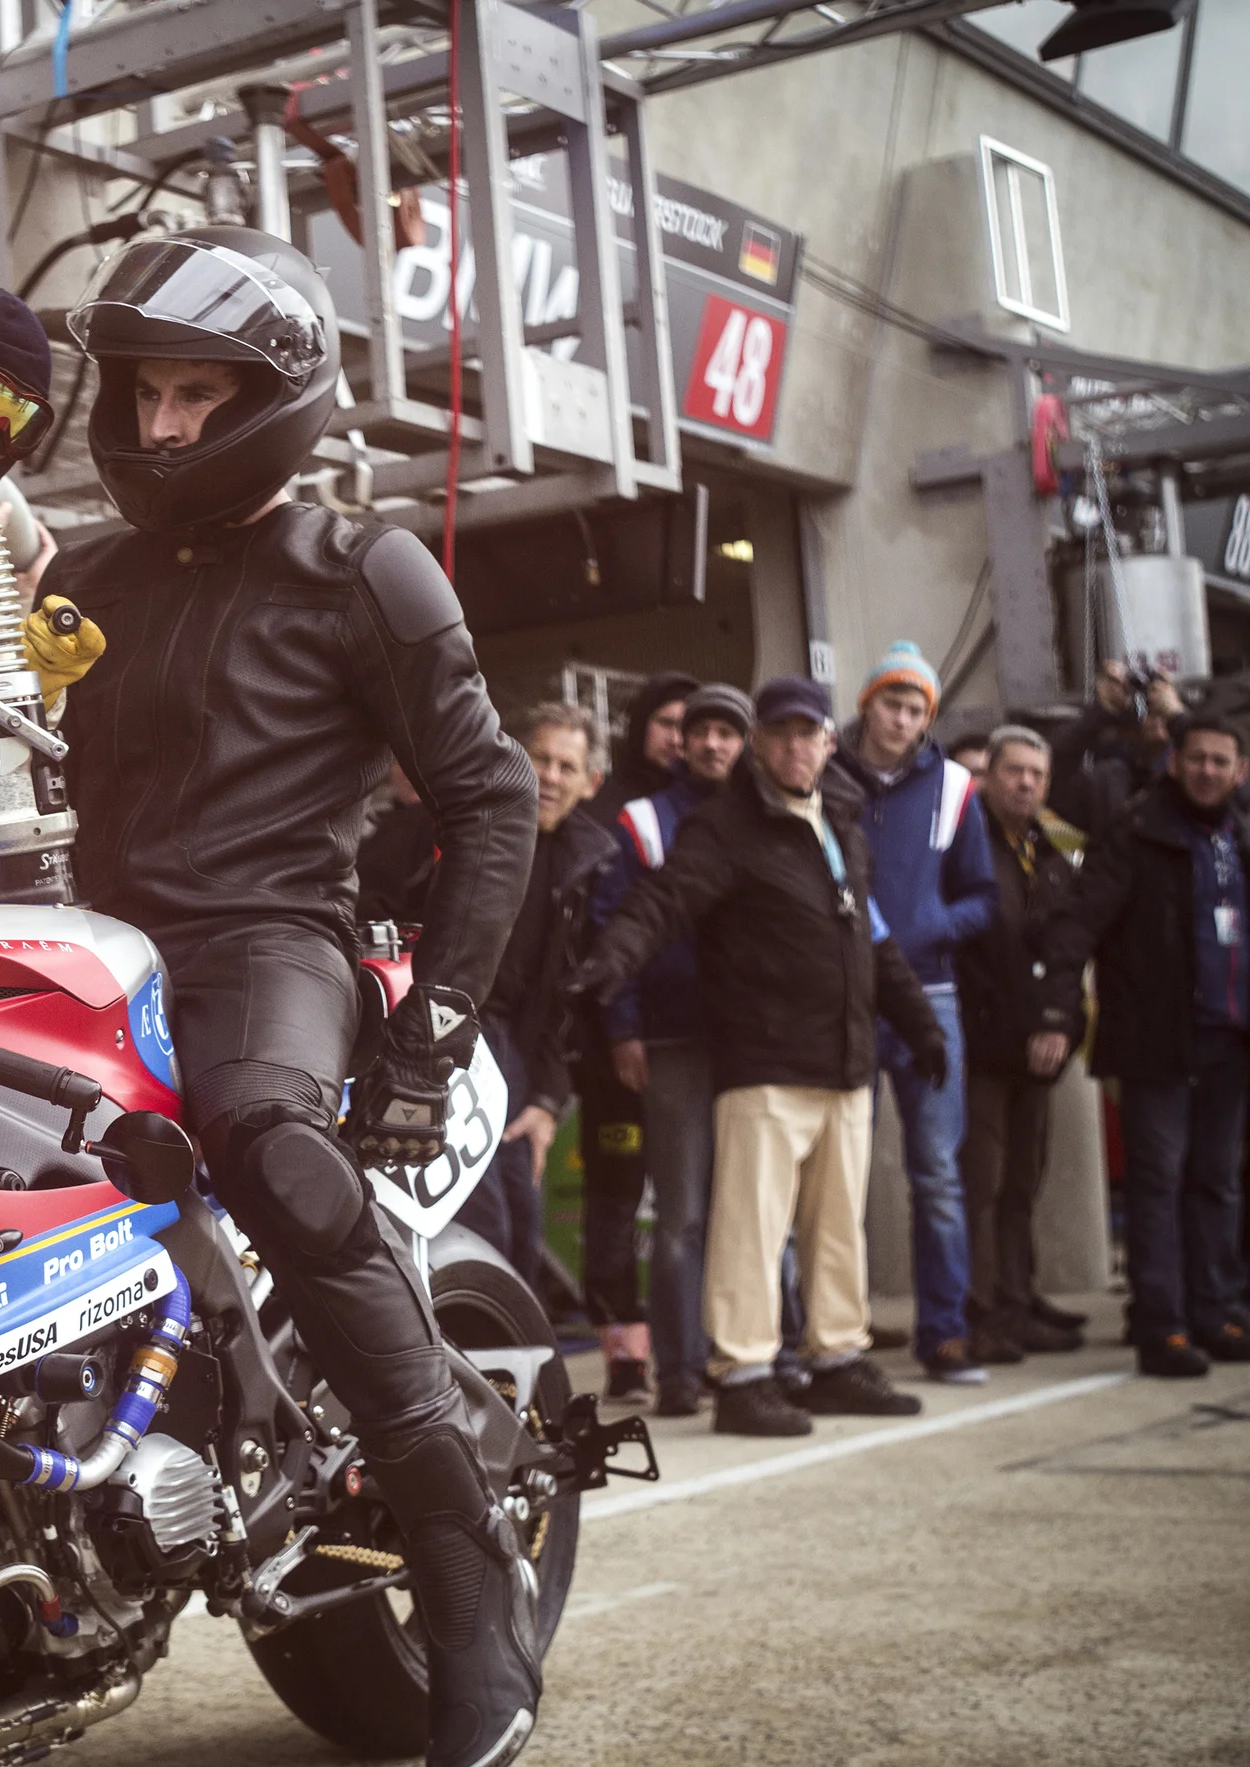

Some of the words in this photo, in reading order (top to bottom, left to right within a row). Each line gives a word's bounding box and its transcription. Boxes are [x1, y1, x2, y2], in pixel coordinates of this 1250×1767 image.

[705, 308, 773, 427] 48
[43, 1248, 84, 1286] Pro
[90, 1218, 134, 1261] Bolt
[79, 1280, 144, 1332] rizoma
